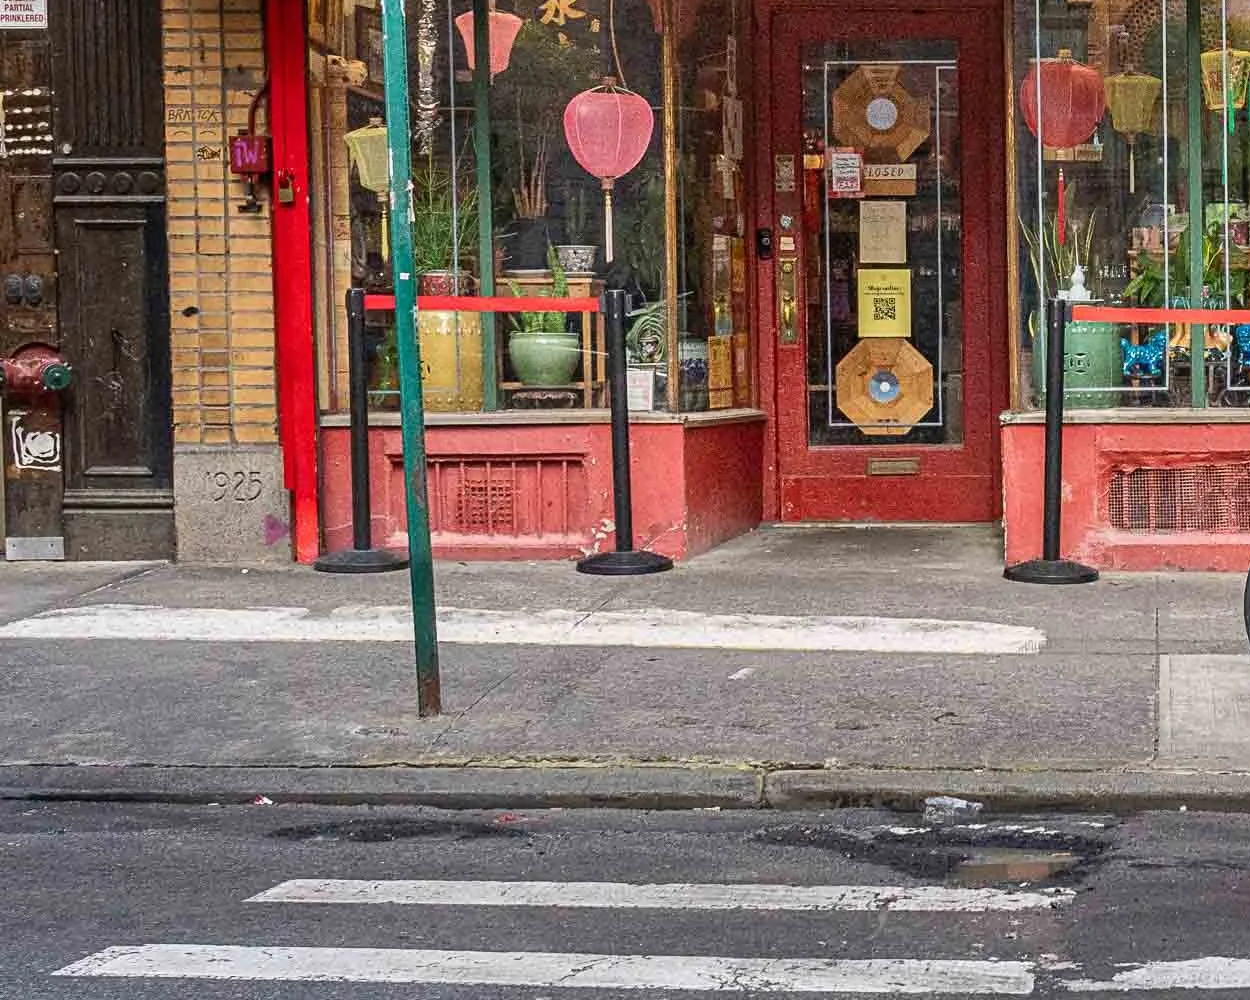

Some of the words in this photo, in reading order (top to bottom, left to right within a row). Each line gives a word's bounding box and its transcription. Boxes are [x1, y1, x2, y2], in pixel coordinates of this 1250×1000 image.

[4, 3, 34, 12] PARTIAL
[0, 14, 44, 22] PRINKLERED
[205, 471, 262, 501] 925
